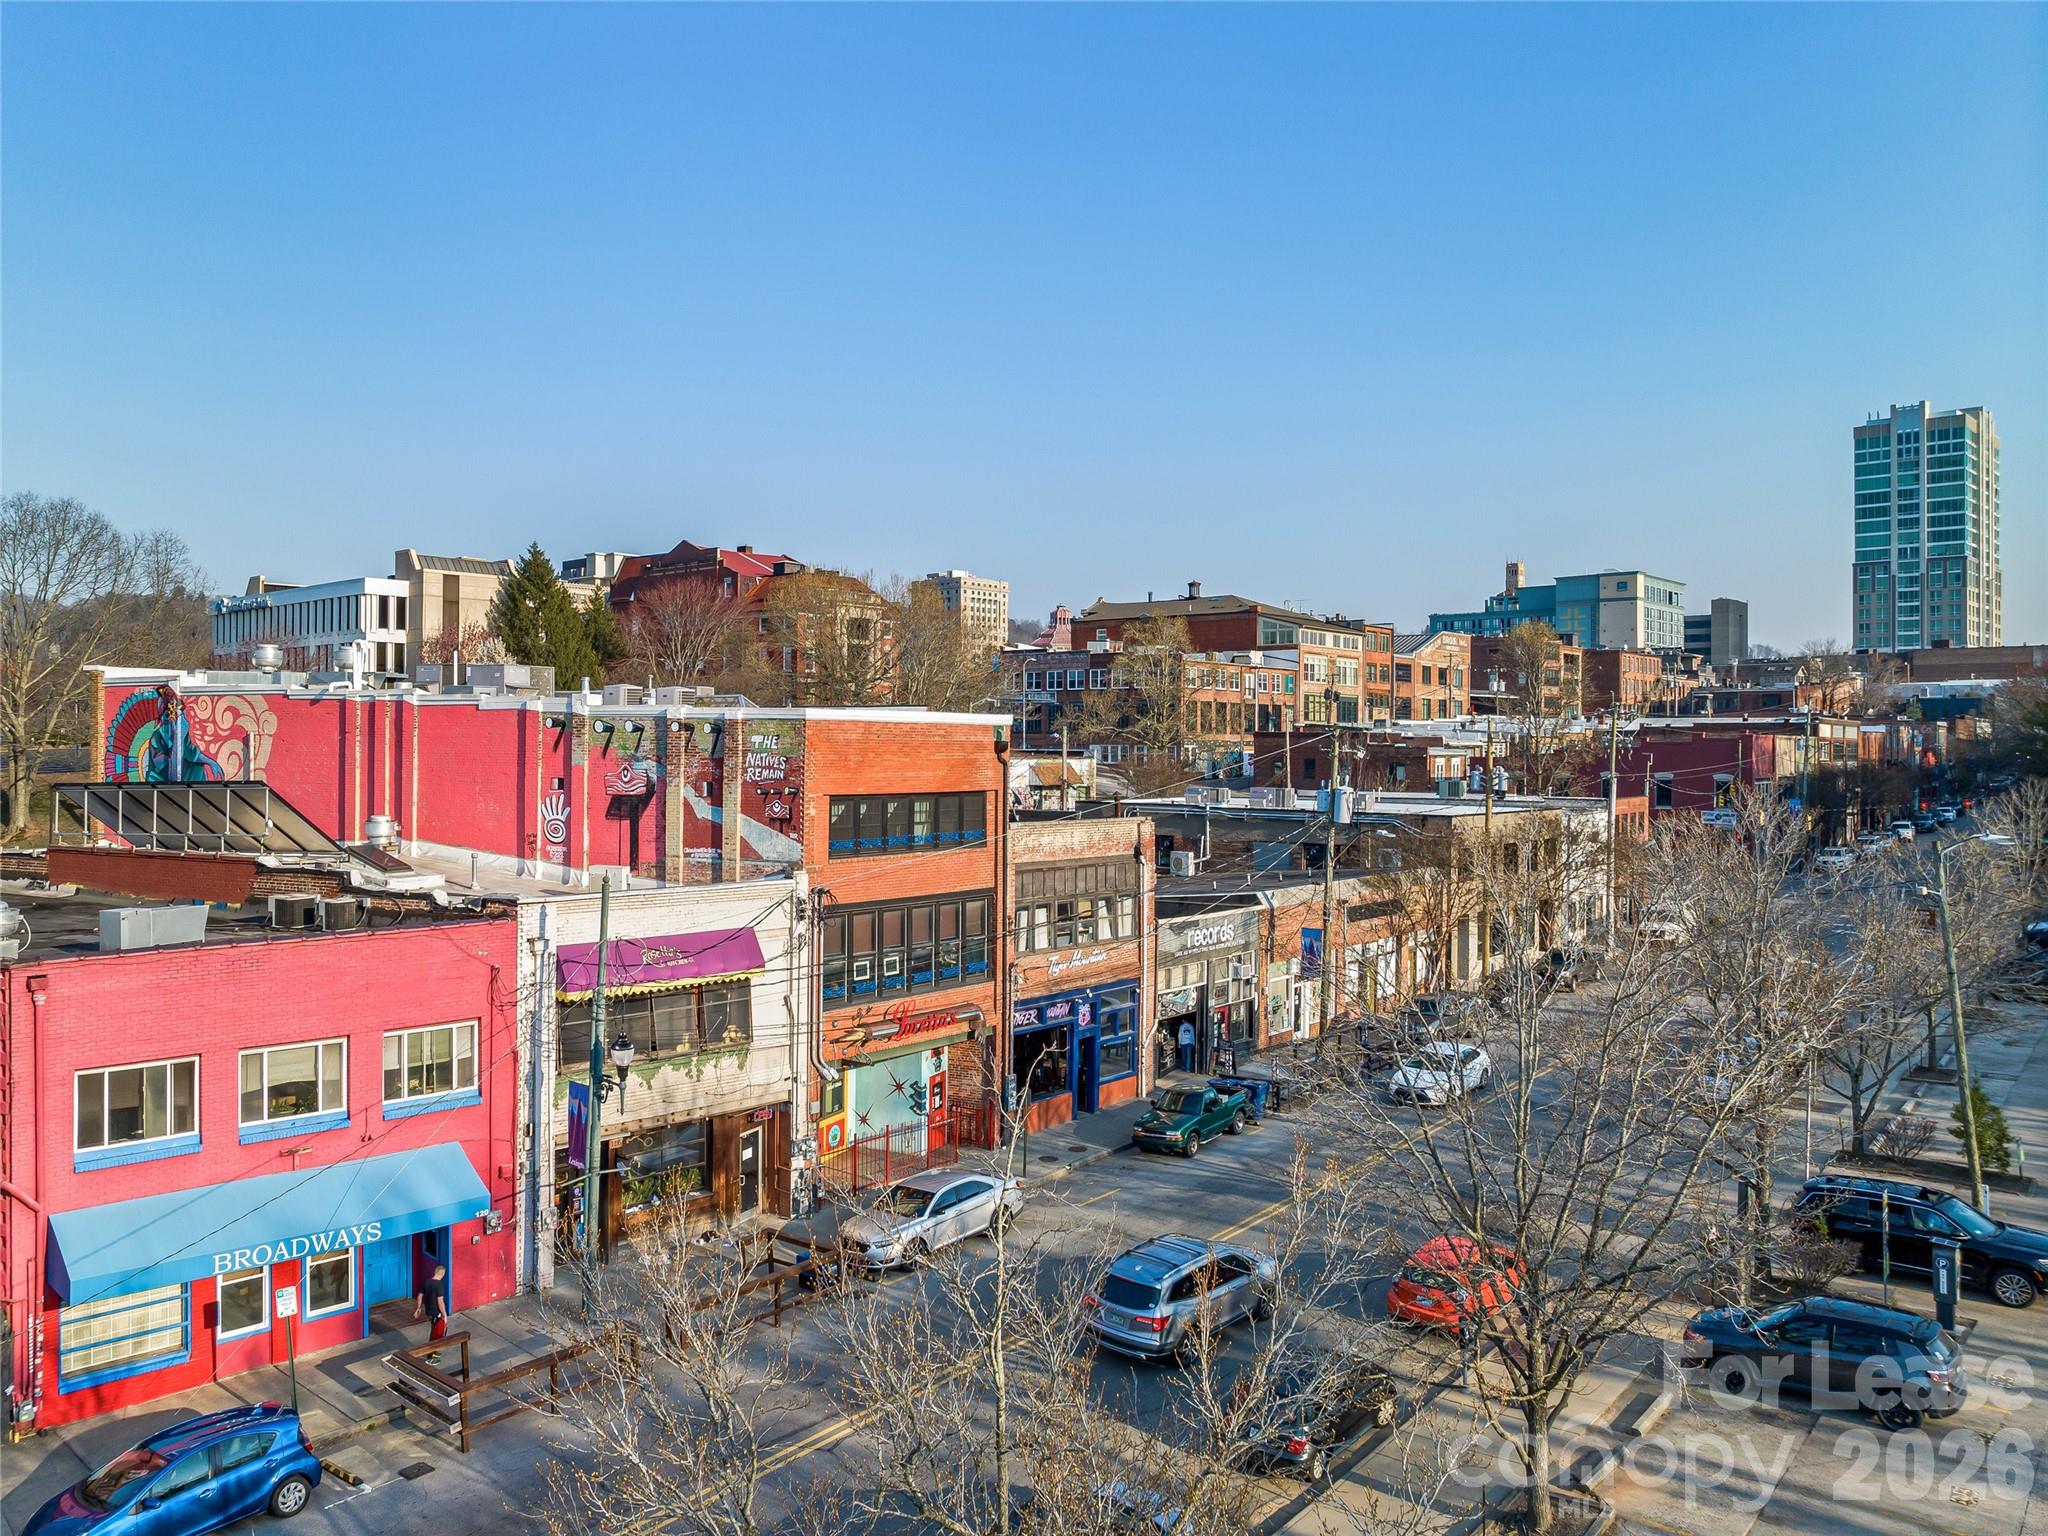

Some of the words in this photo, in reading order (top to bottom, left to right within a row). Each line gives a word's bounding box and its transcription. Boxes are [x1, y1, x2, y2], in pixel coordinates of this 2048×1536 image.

[751, 735, 779, 749] THE
[746, 767, 784, 782] REMAIN
[1187, 919, 1235, 948] records
[475, 1209, 489, 1218] 120
[212, 1221, 382, 1275] BROADWAYS
